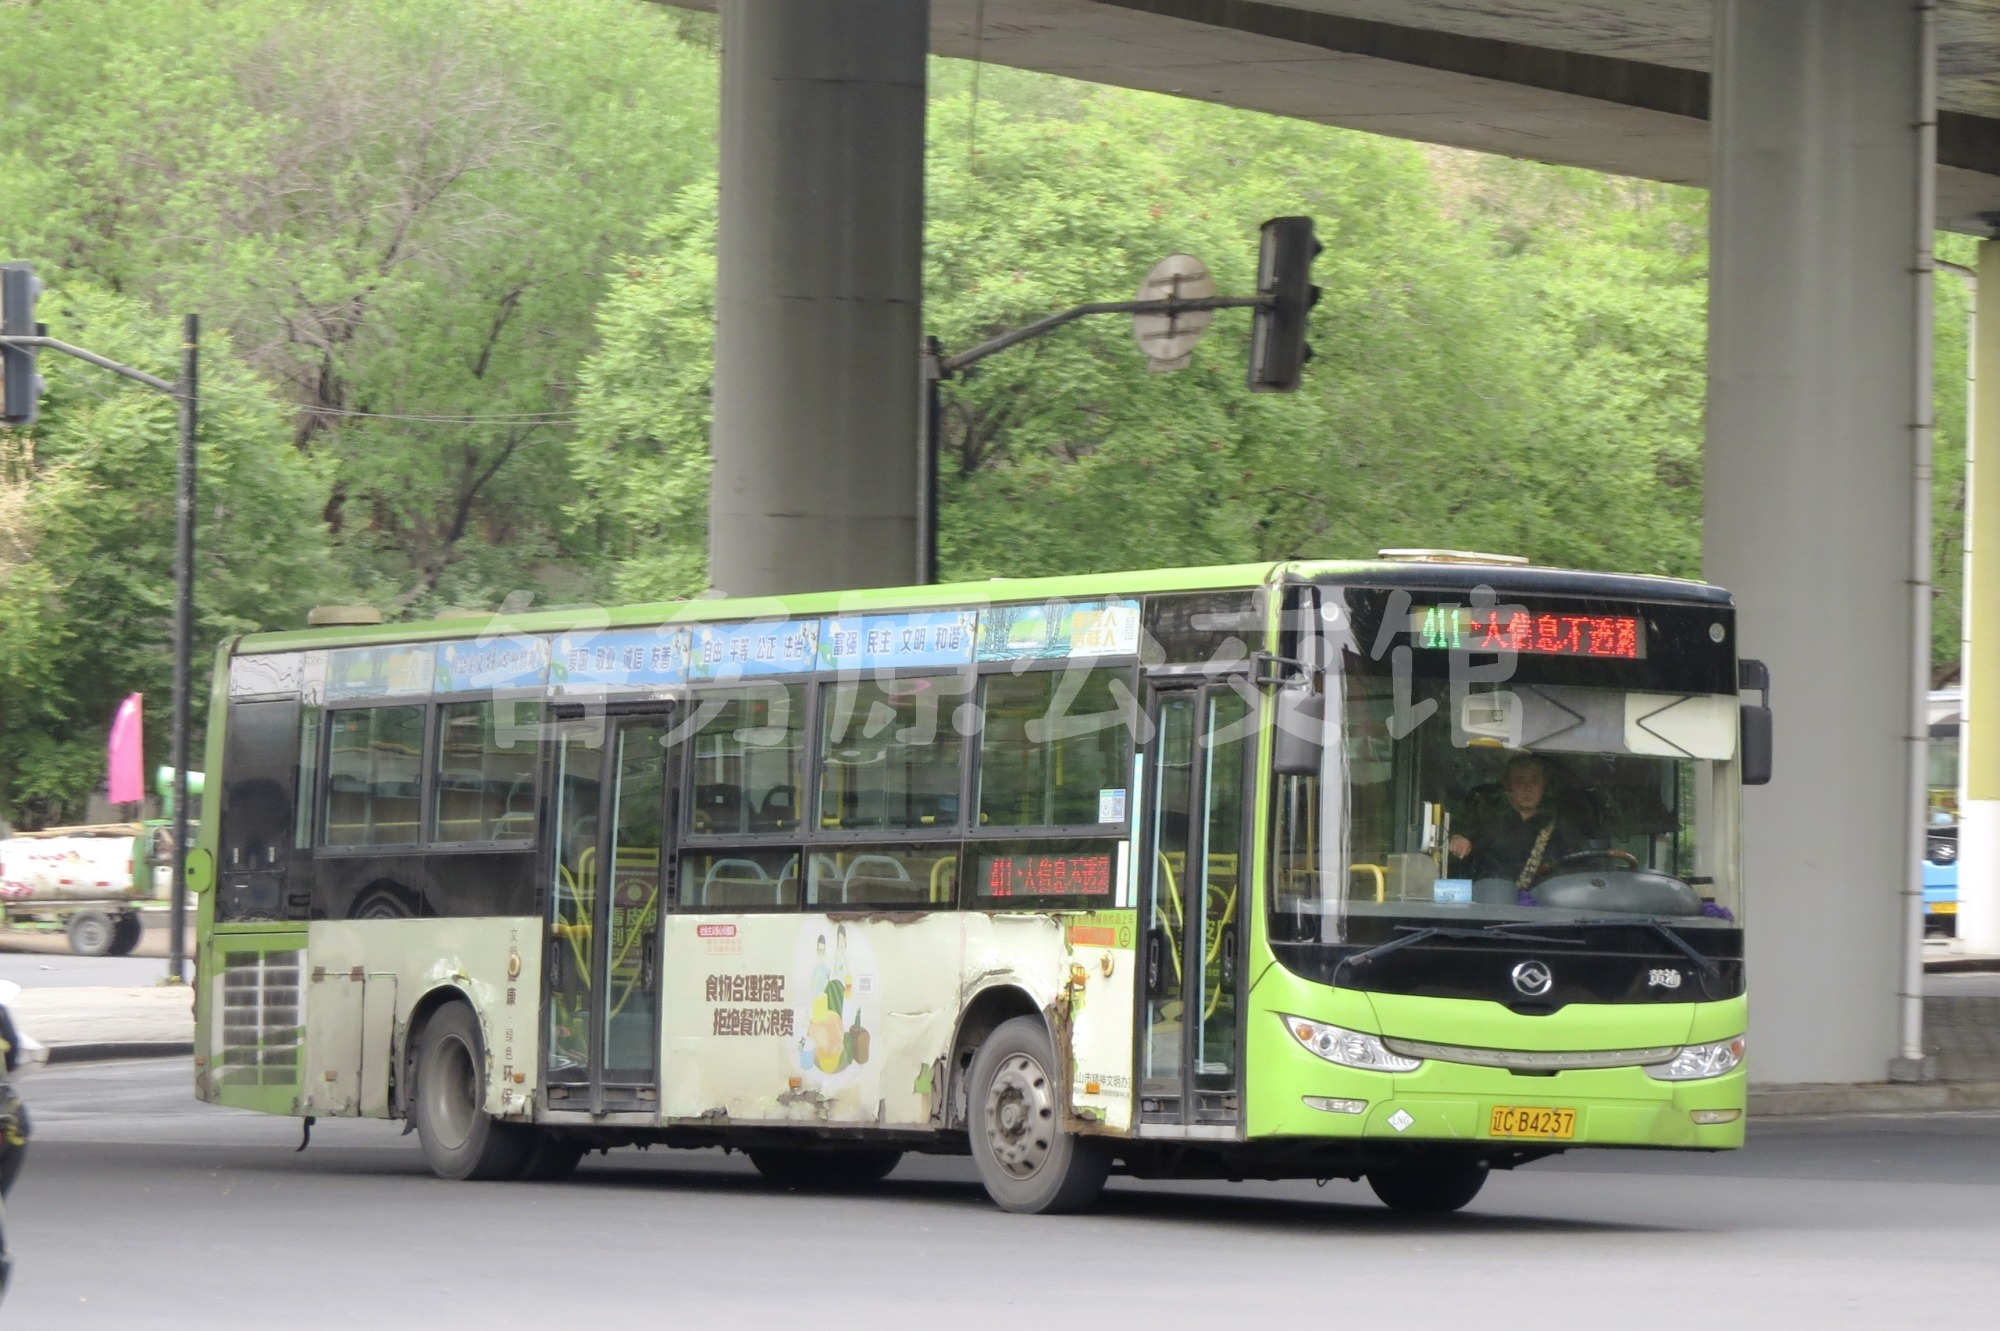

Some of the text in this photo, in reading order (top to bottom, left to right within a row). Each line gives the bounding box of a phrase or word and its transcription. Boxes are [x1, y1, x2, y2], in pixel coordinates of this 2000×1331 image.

[834, 625, 961, 656] 富强 民主 文明 和谐
[1423, 607, 1461, 648] 411
[624, 646, 644, 670] 诚信
[650, 646, 672, 670] 友善
[703, 635, 804, 664] 自由 平等 公正 法治
[705, 974, 785, 1002] 食物合理搭配
[713, 1008, 794, 1036] 拒绝餐饮浪费
